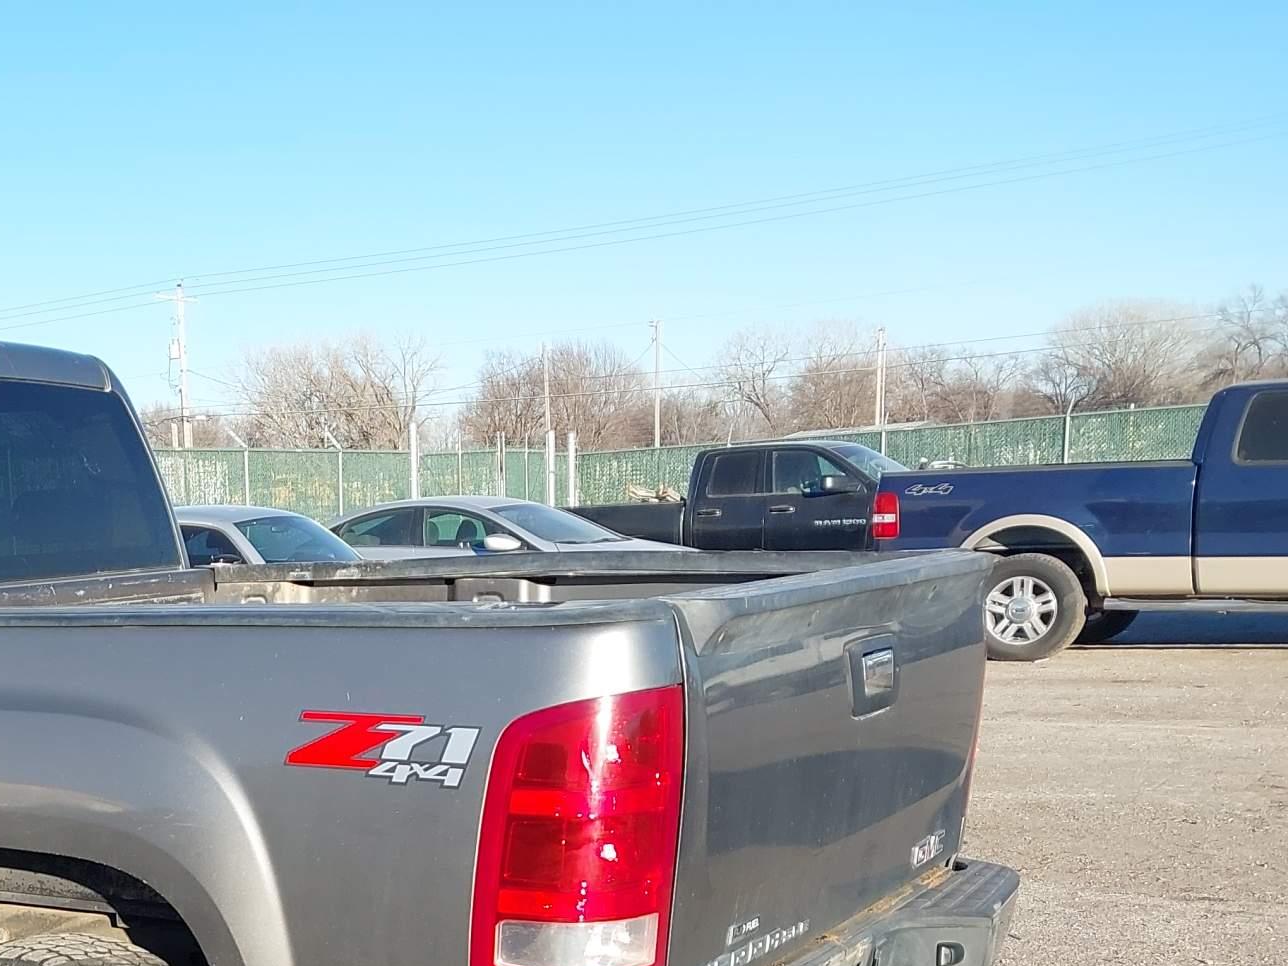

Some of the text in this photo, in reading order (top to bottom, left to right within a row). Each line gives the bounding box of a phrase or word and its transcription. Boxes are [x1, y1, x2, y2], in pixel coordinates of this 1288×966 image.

[905, 483, 954, 496] 4x4
[284, 710, 483, 770] Z71
[910, 828, 946, 869] GMC
